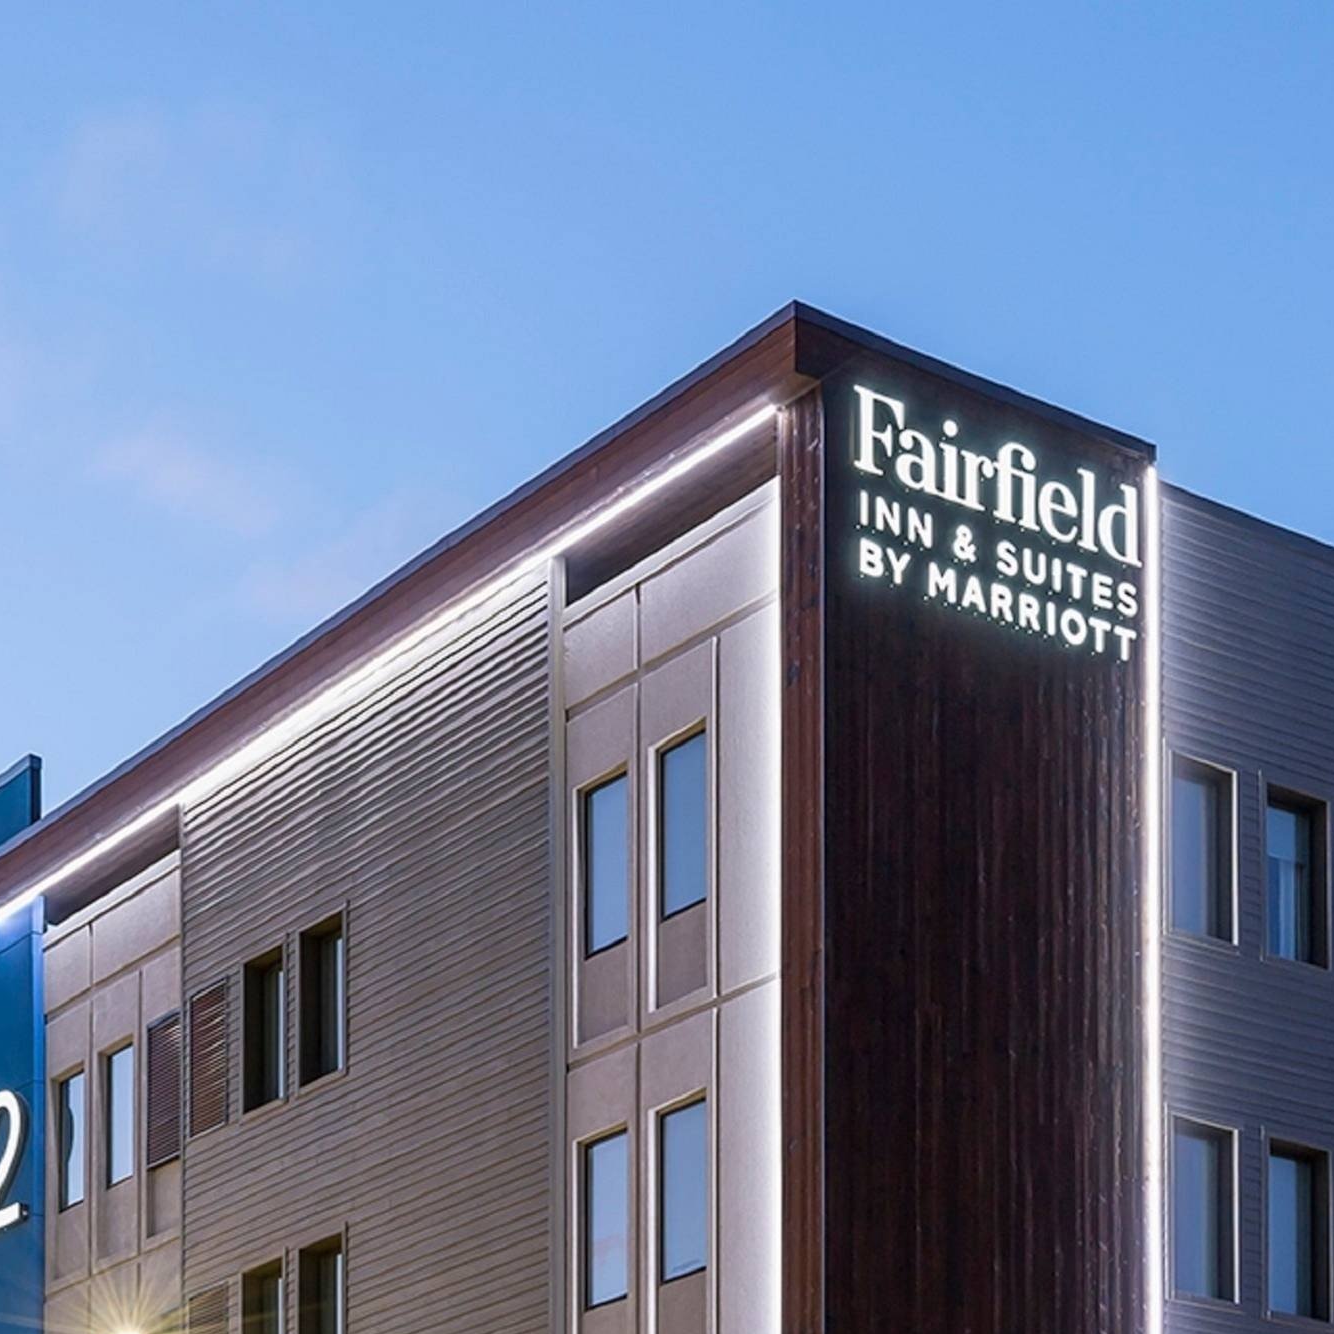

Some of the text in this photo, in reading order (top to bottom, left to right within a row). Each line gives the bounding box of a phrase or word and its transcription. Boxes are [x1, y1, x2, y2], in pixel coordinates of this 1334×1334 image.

[853, 384, 1142, 568] Fairfield
[859, 537, 1137, 662] BY MARRIOTT
[860, 490, 1138, 617] INN & SUITES
